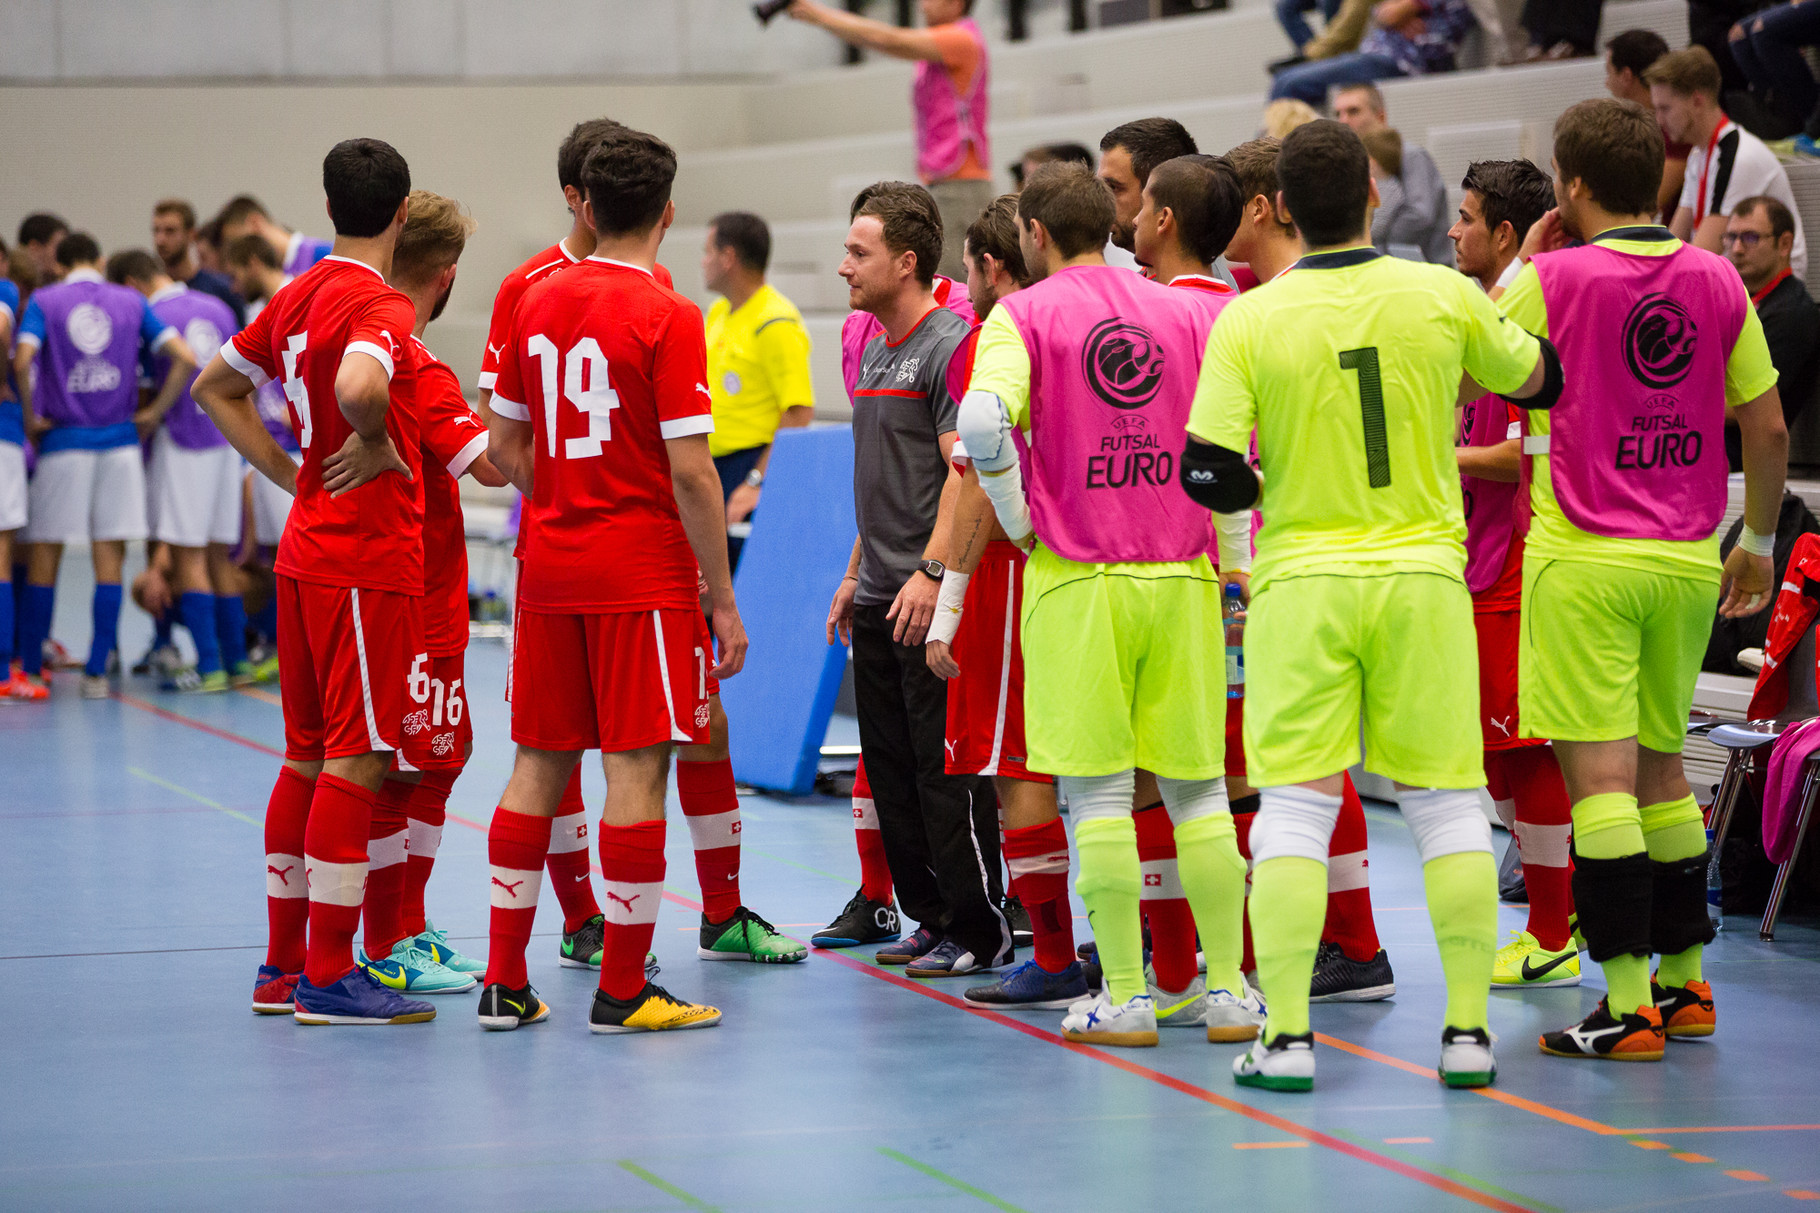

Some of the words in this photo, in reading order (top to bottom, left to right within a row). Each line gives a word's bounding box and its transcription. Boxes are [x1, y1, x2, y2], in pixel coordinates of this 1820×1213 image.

[528, 333, 620, 459] 19
[1647, 397, 1675, 409] UEFA
[1113, 417, 1146, 429] UEFA
[1338, 347, 1391, 488] 1
[1632, 414, 1688, 432] FUTSAL
[1101, 434, 1160, 451] FUTSAL
[1615, 430, 1703, 470] EURO
[1087, 451, 1173, 489] EURO
[407, 652, 430, 703] 6
[431, 678, 463, 726] 16
